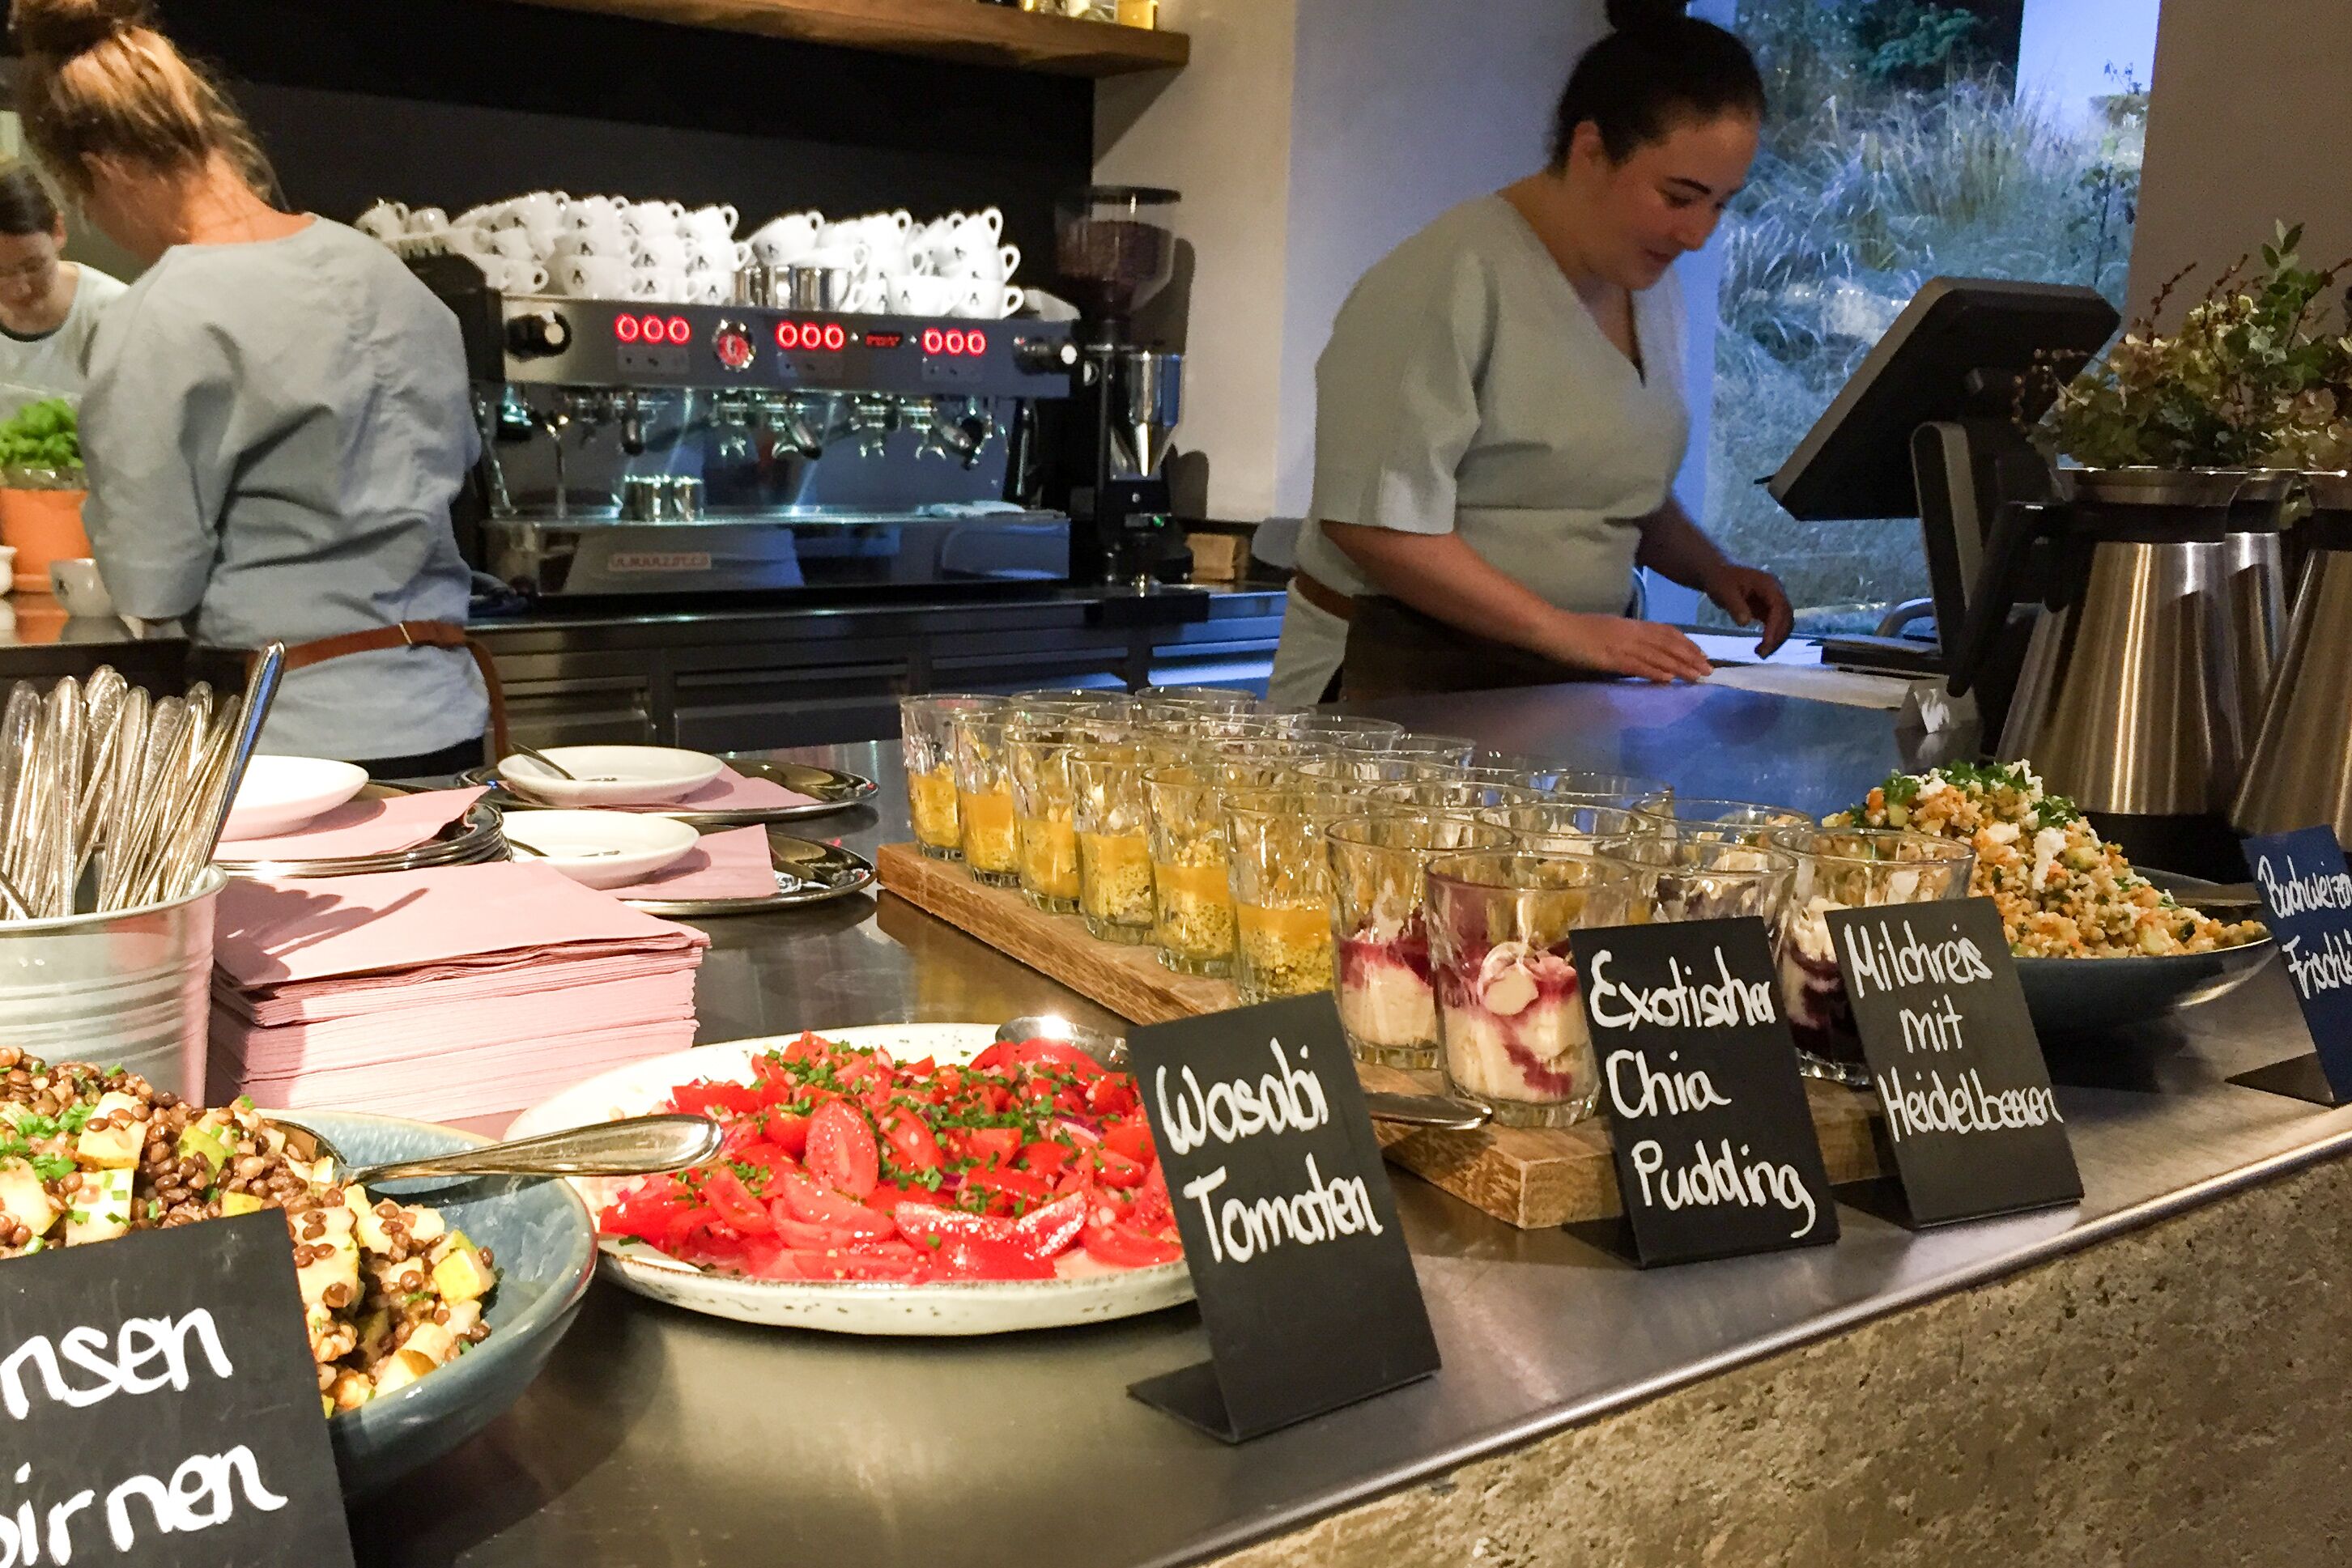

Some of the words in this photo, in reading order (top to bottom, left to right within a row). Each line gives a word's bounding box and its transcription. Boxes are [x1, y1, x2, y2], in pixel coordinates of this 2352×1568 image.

[1844, 920, 1993, 999] Milchreis
[2282, 929, 2352, 1000] Frischk
[1899, 993, 1963, 1054] mit
[1155, 1037, 1329, 1155] Wasabi
[1606, 1049, 1732, 1120] Chia
[1183, 1152, 1384, 1263] Tomaten
[1631, 1138, 1816, 1239] Pudding
[0, 1307, 234, 1421] nsen
